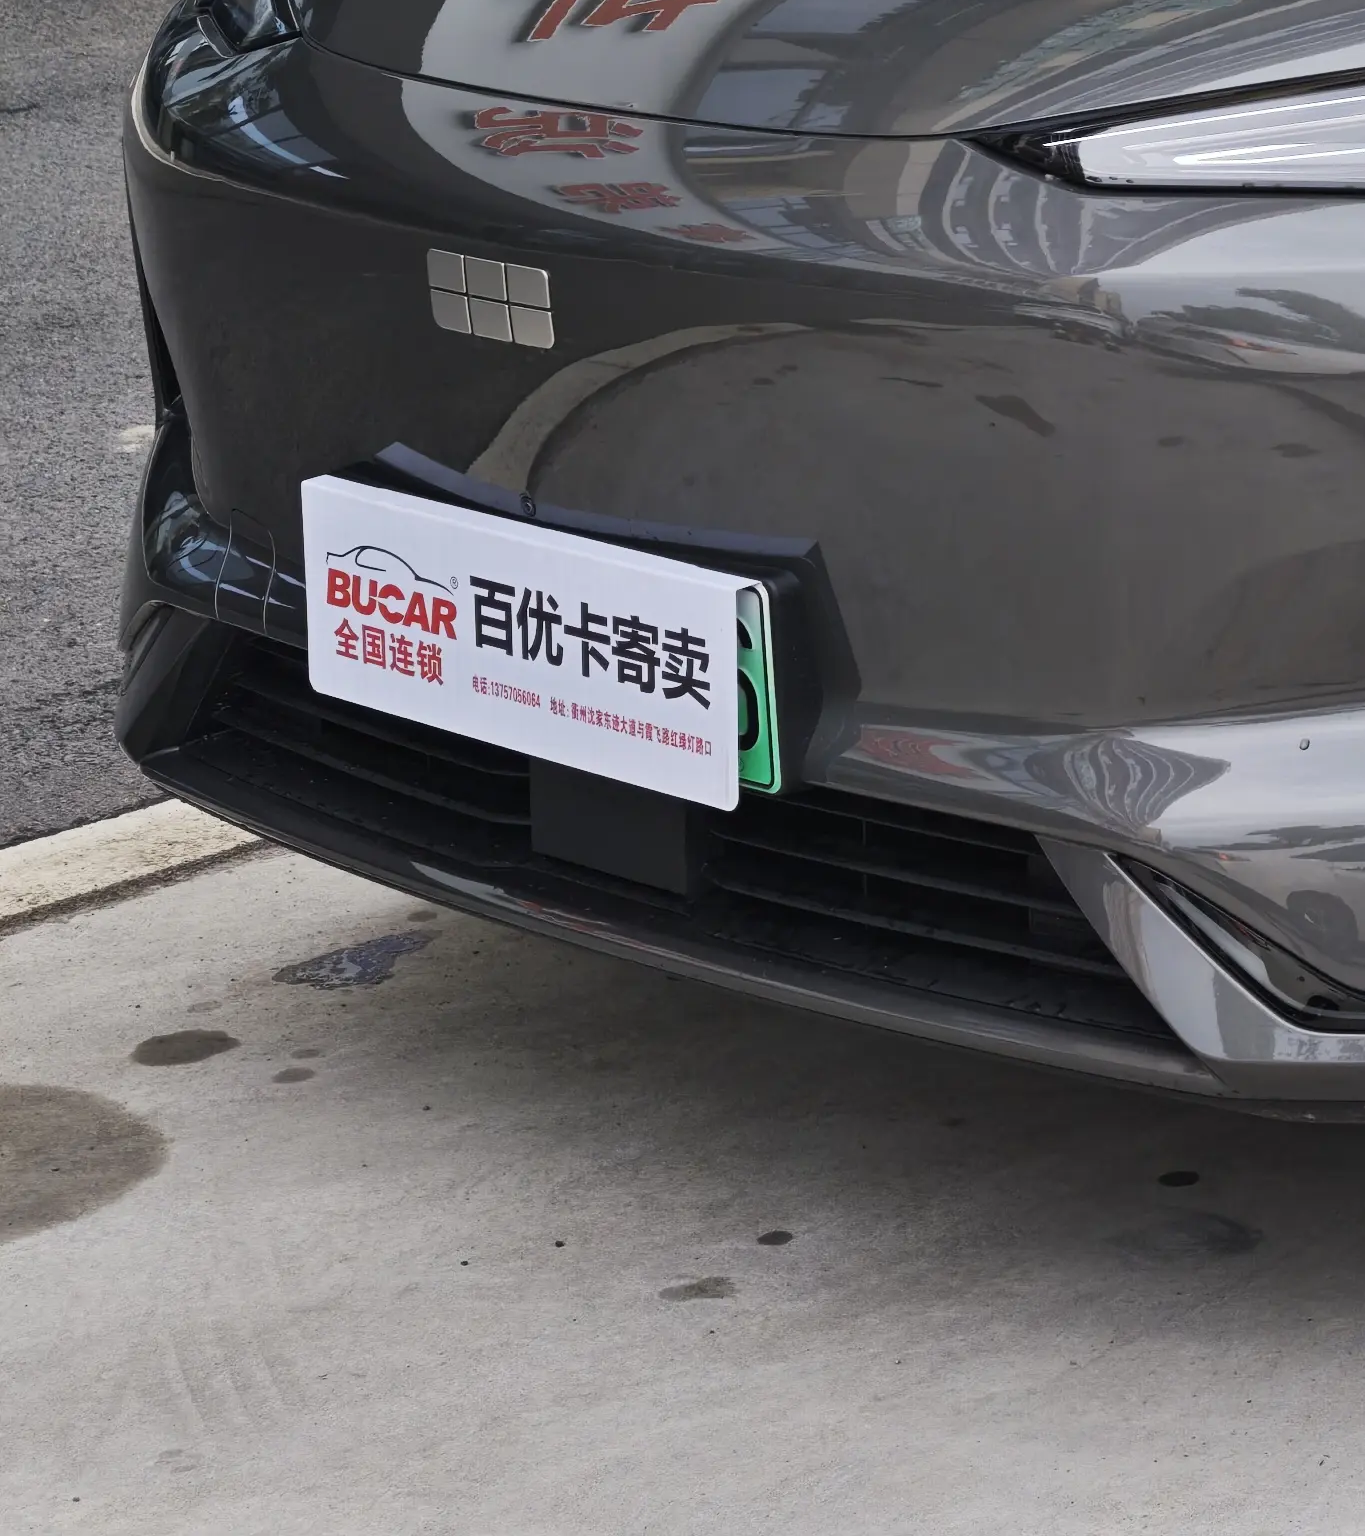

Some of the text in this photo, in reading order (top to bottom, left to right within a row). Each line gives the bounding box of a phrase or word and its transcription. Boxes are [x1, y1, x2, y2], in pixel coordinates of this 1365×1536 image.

[326, 567, 458, 640] BUCAR
[334, 617, 444, 687] 全国连锁
[469, 574, 713, 711] 百优卡寄卖
